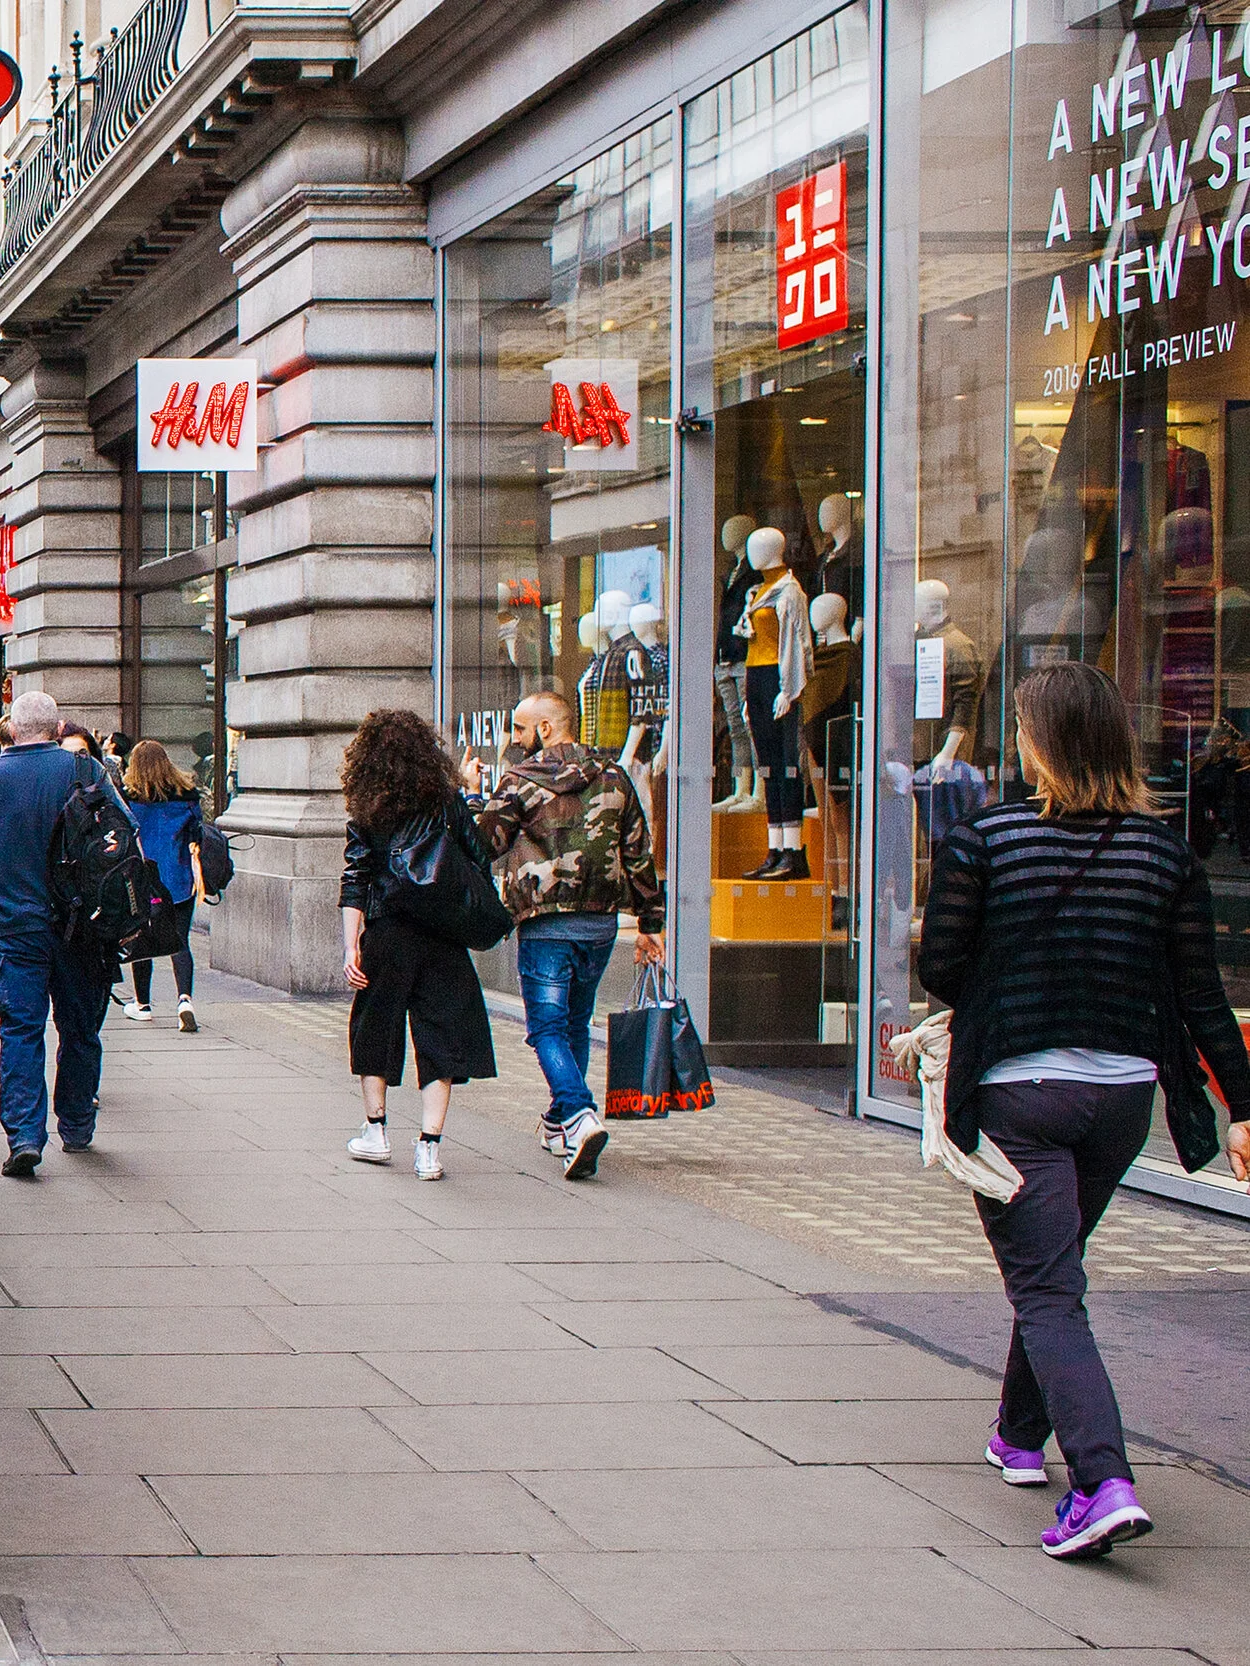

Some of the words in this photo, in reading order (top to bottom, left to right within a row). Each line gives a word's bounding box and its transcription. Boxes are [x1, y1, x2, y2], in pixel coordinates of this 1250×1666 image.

[1048, 99, 1073, 161] A
[1091, 42, 1192, 143] NEW
[1211, 27, 1250, 95] L
[1045, 187, 1072, 249] A
[1089, 139, 1189, 234] NEW
[1043, 274, 1070, 336] A
[1087, 234, 1186, 324] NEW
[1043, 362, 1081, 397] 2016
[1086, 349, 1136, 386] FALL
[1143, 320, 1237, 372] PREVIEW
[150, 381, 250, 450] H&M
[456, 712, 467, 747] A
[471, 709, 507, 747] NEW
[880, 1059, 911, 1082] COLLE
